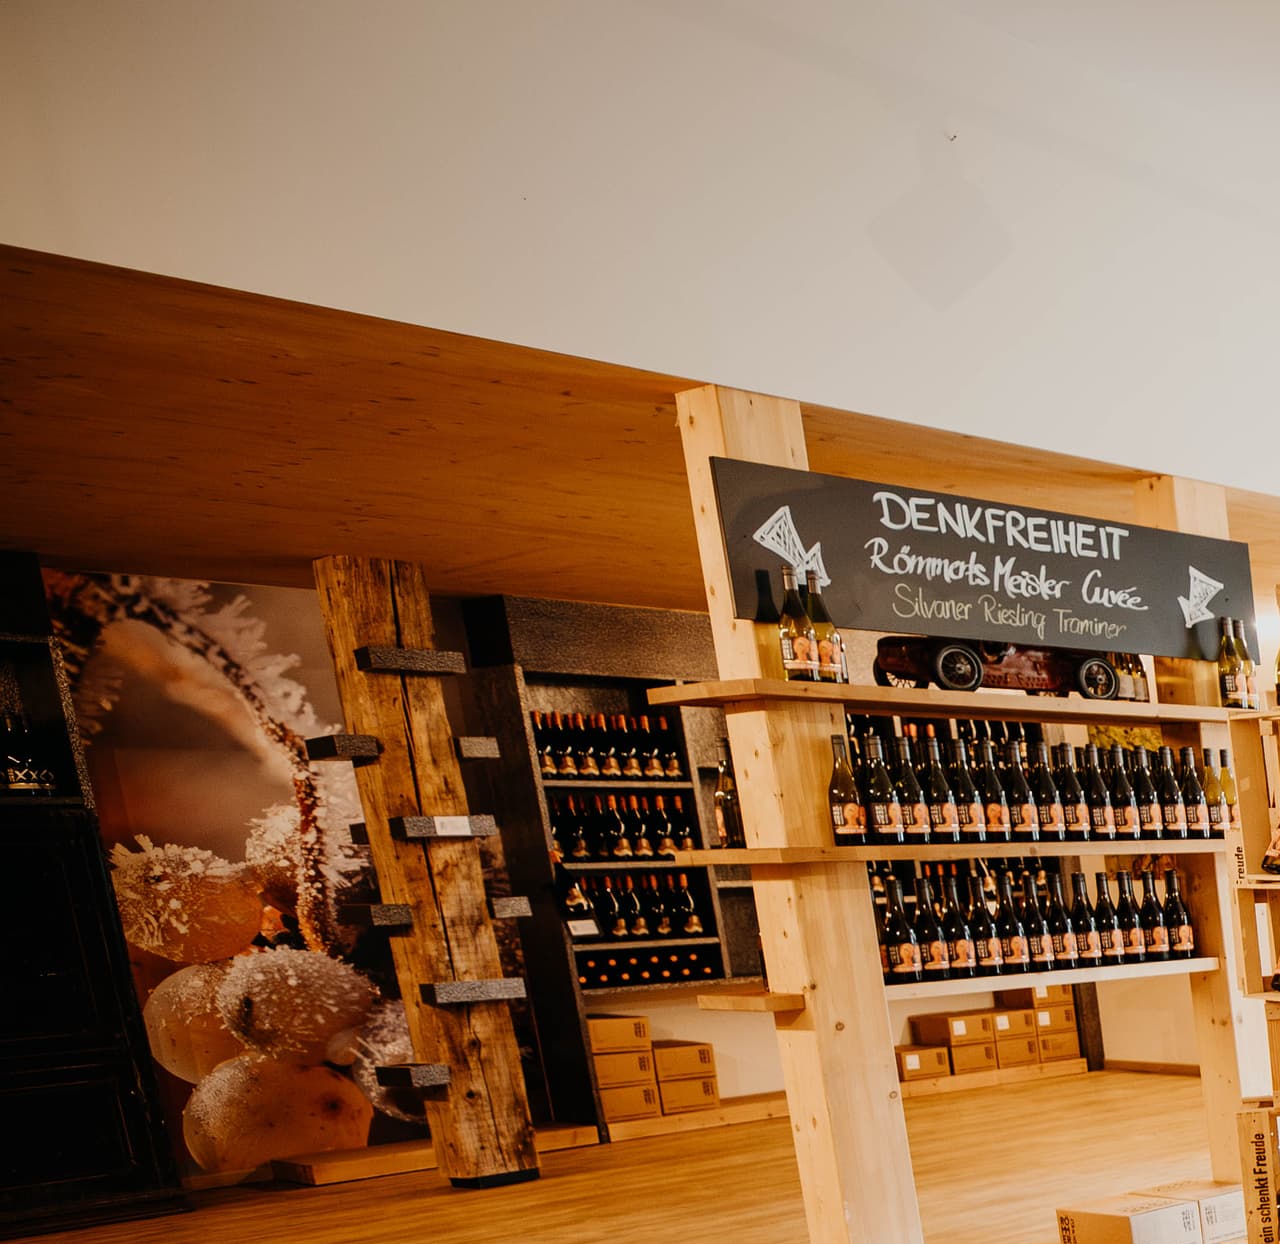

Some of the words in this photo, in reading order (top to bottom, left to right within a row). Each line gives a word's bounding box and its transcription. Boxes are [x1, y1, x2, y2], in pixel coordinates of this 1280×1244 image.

[872, 491, 1130, 560] DENKFREIHEIT
[993, 555, 1072, 600] Meister
[1081, 569, 1149, 612] Cuvée
[892, 583, 973, 622] Silvaner
[977, 594, 1047, 640] Riesling
[1052, 608, 1127, 638] Traminer
[1234, 846, 1245, 884] reude
[1250, 1133, 1267, 1175] Freude
[1255, 1177, 1272, 1224] schenkt
